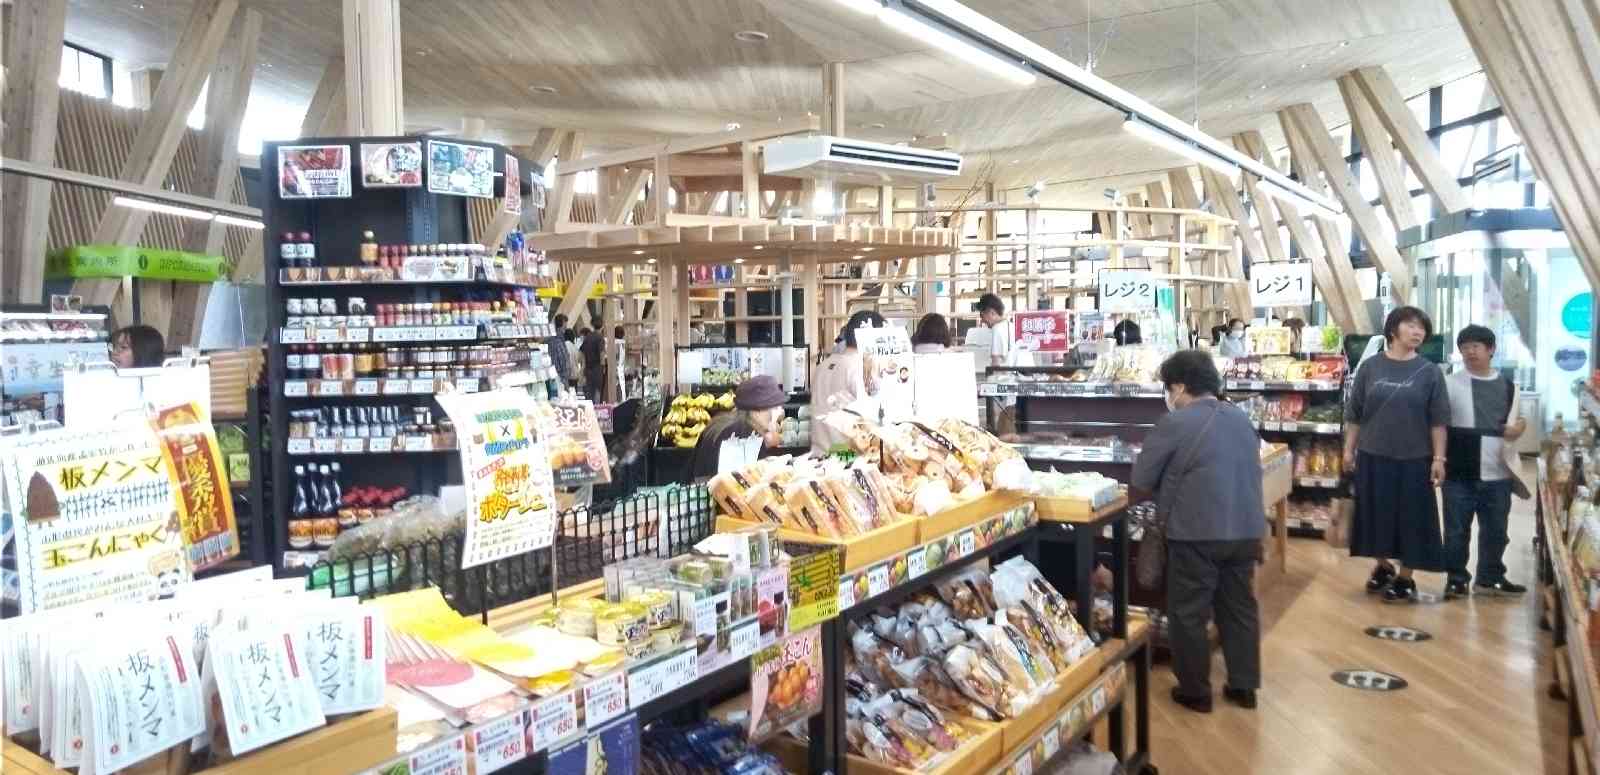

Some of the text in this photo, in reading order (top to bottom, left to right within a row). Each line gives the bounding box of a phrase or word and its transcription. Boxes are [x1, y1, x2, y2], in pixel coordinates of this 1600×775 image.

[1105, 282, 1149, 297] レジ2
[1257, 275, 1303, 294] レジ1
[60, 456, 162, 490] 板メンマ
[42, 524, 166, 570] 玉こんにゃく
[247, 642, 282, 722] 板メンマ
[317, 621, 344, 700] 板メンマ
[126, 649, 162, 736] 板メンマ
